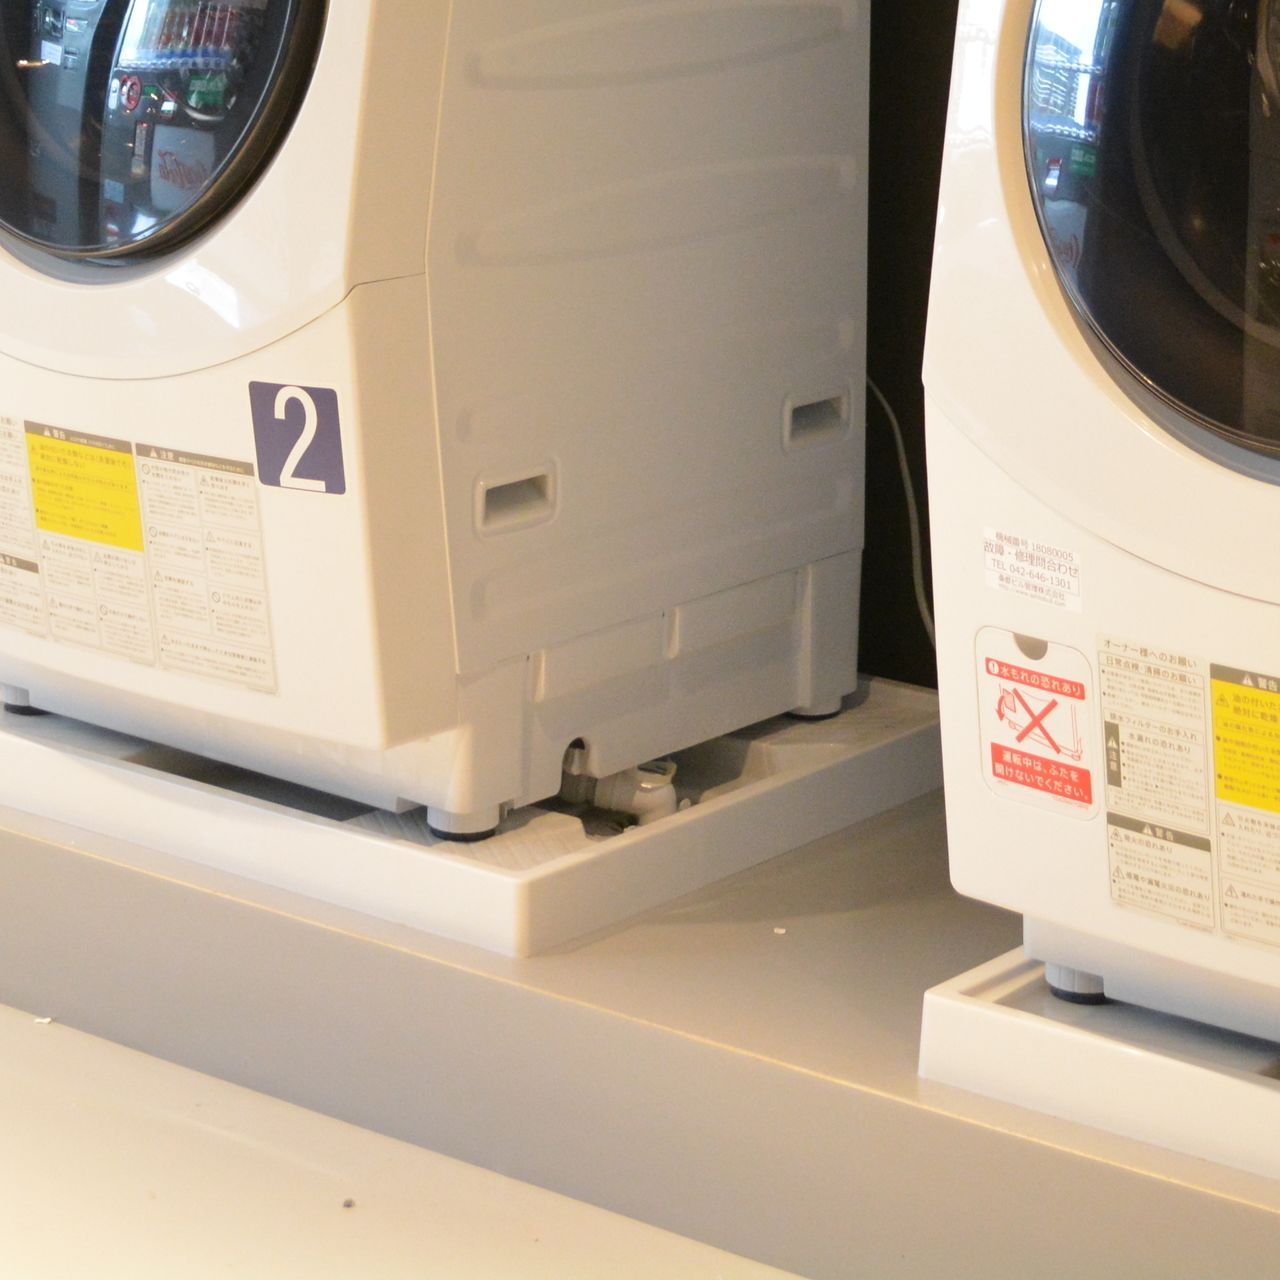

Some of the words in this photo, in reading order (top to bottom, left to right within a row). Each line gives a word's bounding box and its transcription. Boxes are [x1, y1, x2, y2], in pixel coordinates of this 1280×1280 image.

[274, 385, 327, 493] 2
[991, 558, 1007, 571] TEL
[1009, 563, 1071, 590] 042-646-1301
[1104, 639, 1197, 669] オーナー様へのお願い
[1000, 665, 1081, 697] 水もれの恐れあり
[1256, 676, 1278, 693] 警告
[994, 763, 1089, 801] 開けないでください。
[1001, 750, 1080, 783] 運転中は、ふたを
